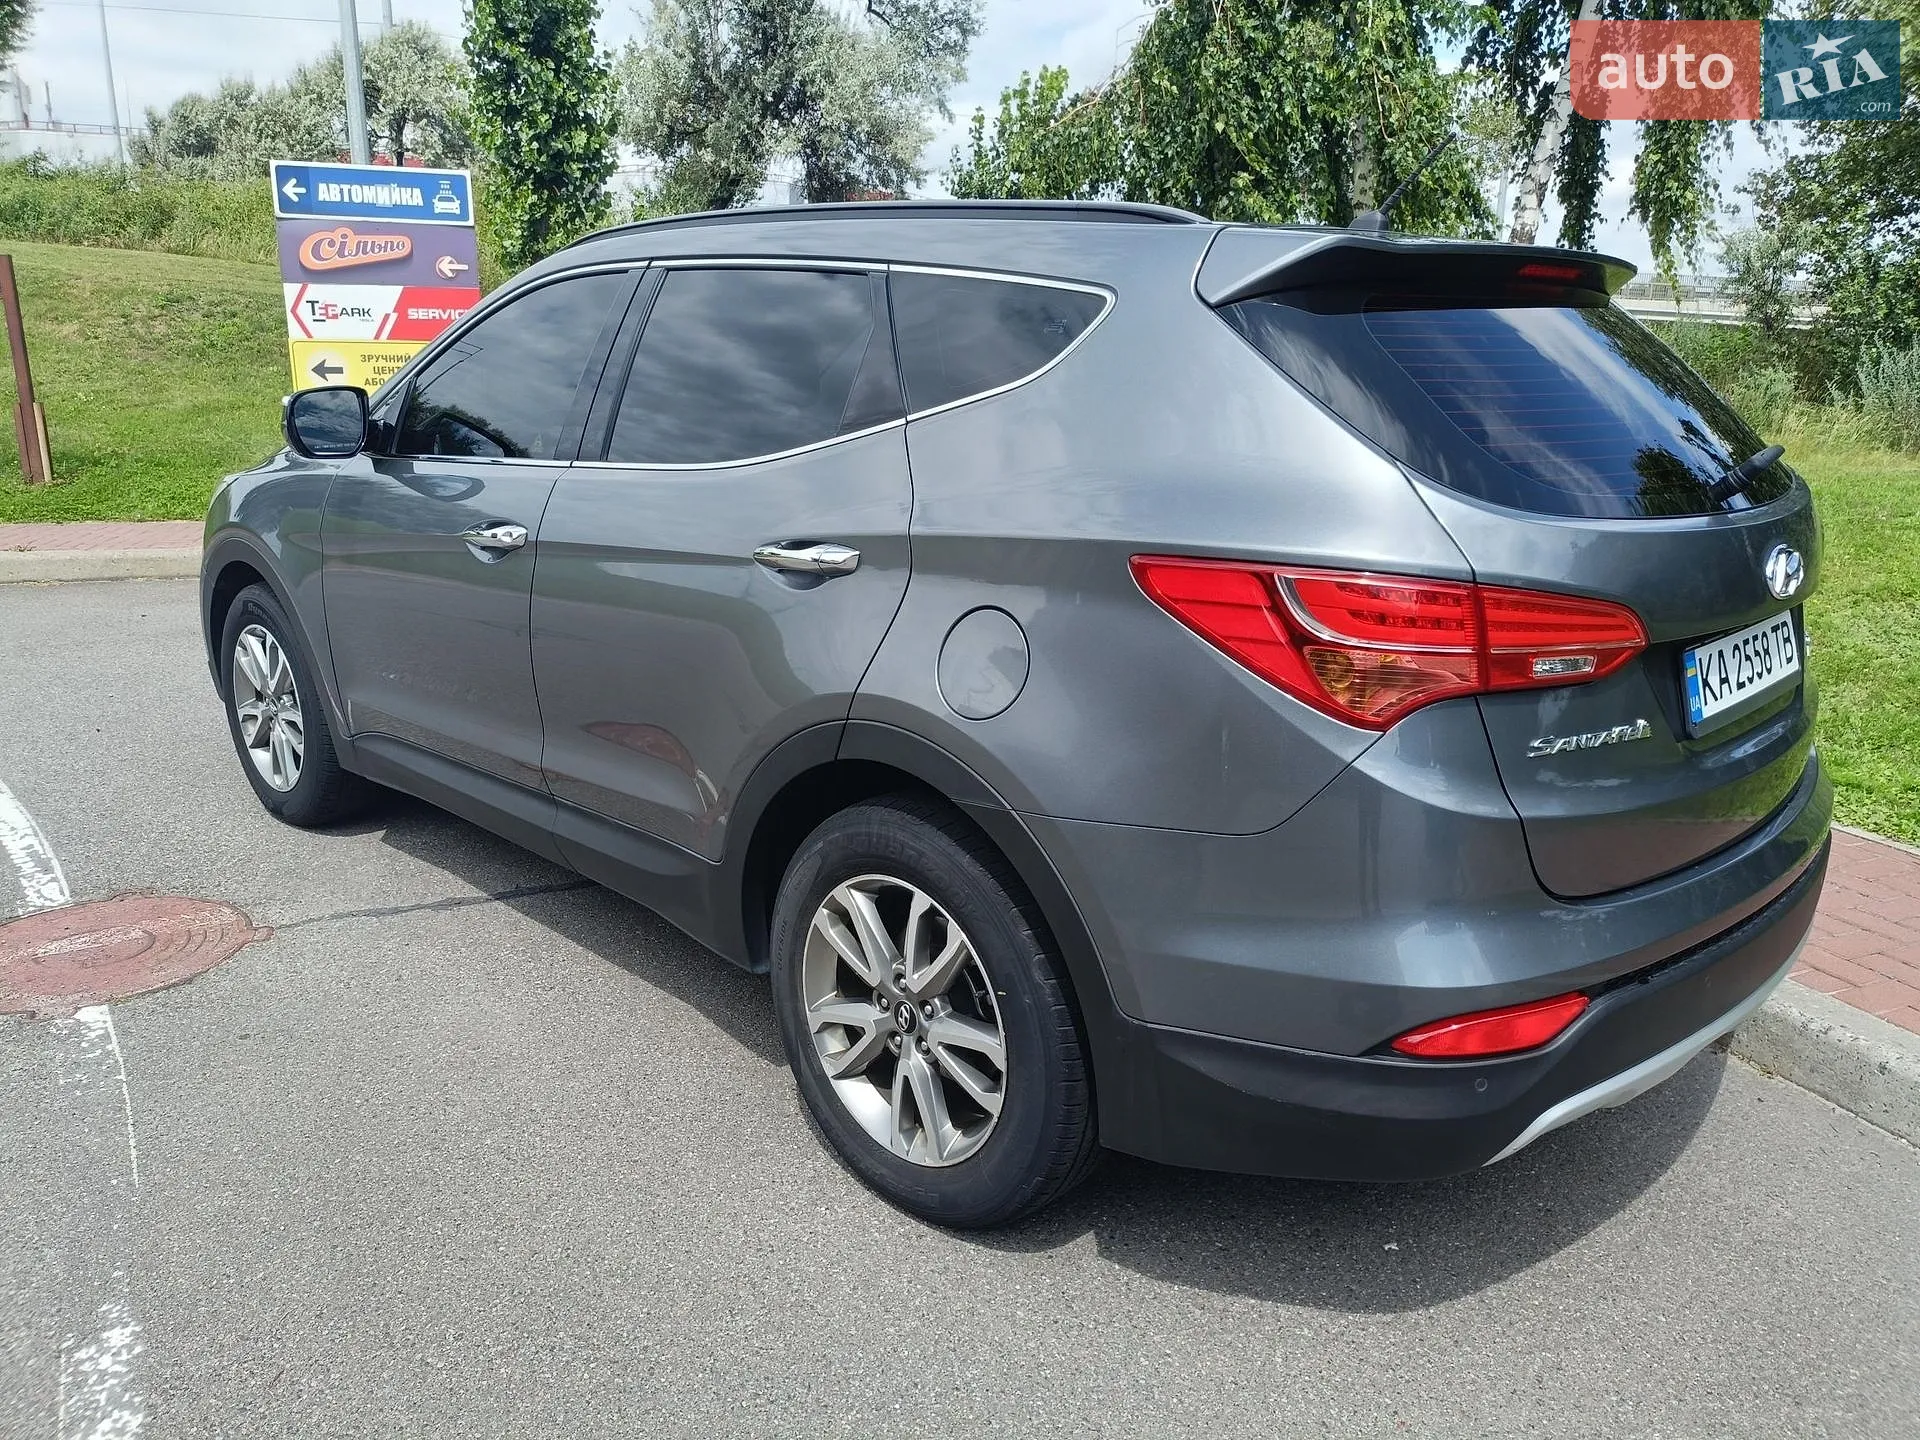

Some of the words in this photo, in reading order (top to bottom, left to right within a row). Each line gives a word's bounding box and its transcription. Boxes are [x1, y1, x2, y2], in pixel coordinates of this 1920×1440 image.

[318, 182, 424, 207] АВТОМИЙКА
[311, 233, 405, 262] Сільпо
[407, 307, 468, 321] SERVIC
[360, 353, 411, 363] ЗРУЧНИЙ
[364, 377, 385, 386] АБО
[1699, 650, 1732, 706] KA
[1736, 636, 1772, 691] 2558
[1771, 621, 1794, 669] TB
[1690, 696, 1701, 712] UA
